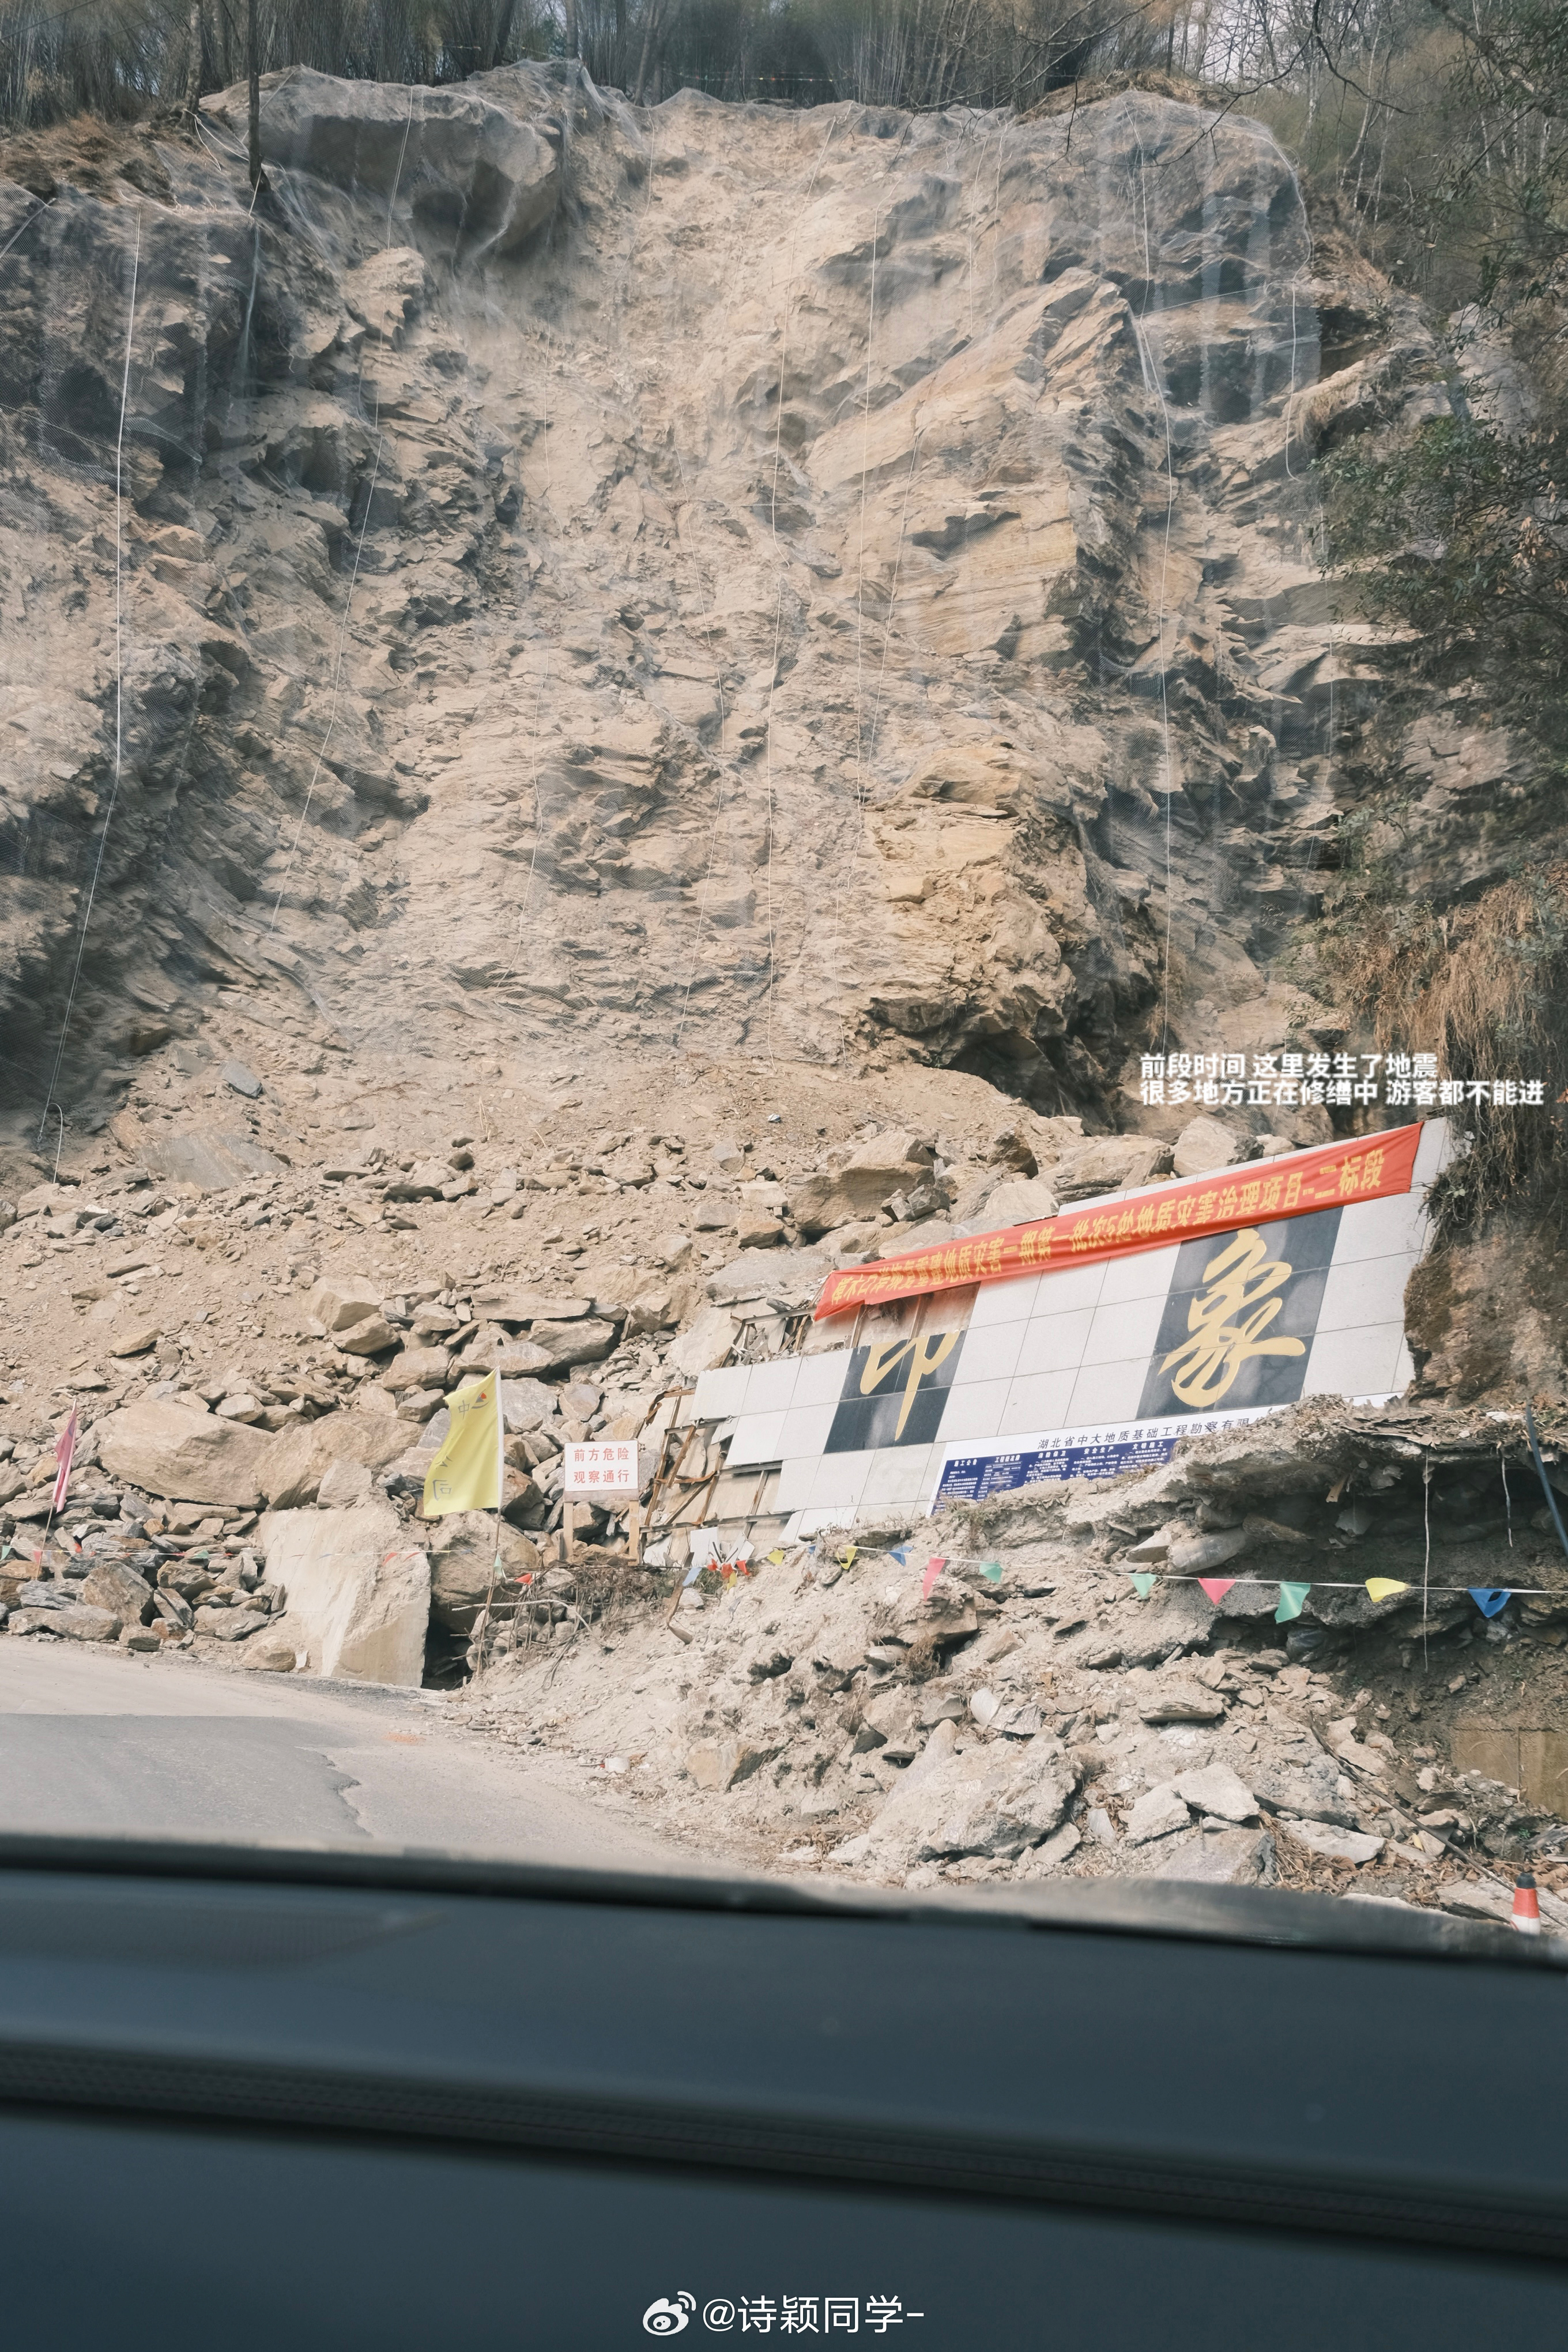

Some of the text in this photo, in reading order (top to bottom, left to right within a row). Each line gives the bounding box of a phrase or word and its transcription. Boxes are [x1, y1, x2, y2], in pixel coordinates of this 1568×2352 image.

[574, 1448, 630, 1461] 前方危险
[1084, 1446, 1114, 1454] 安全生产
[574, 1469, 630, 1483] 观察通行
